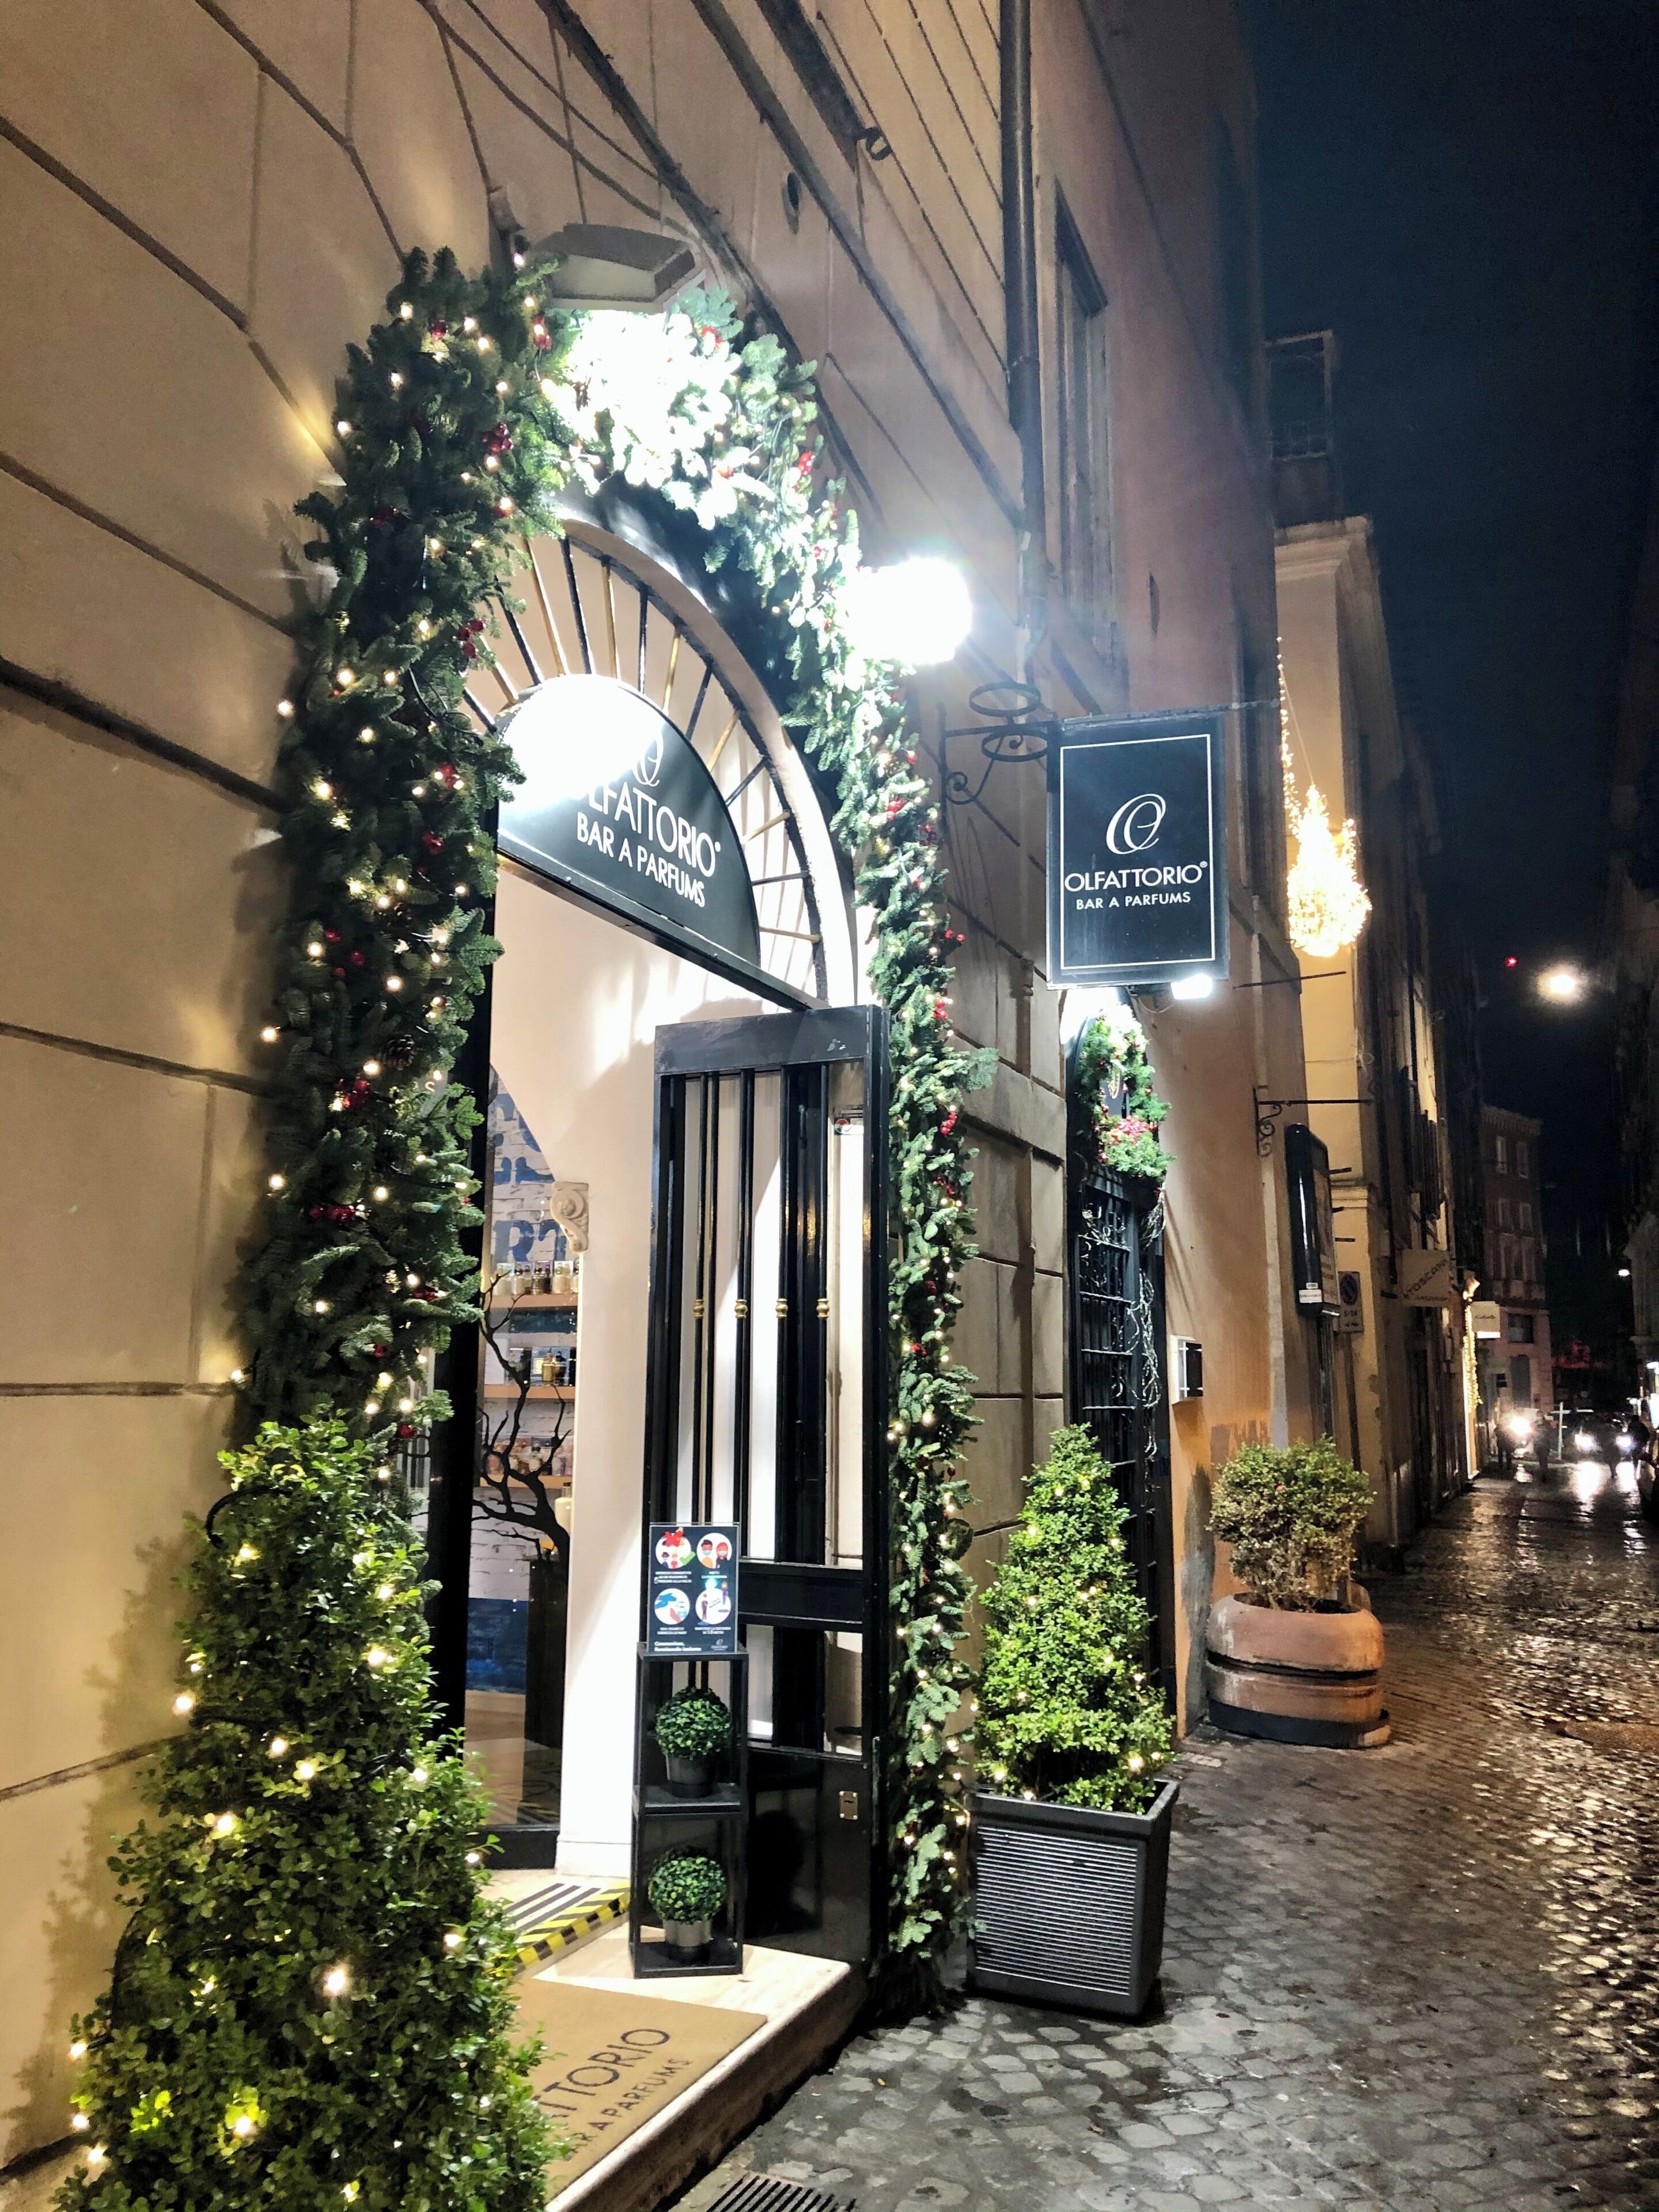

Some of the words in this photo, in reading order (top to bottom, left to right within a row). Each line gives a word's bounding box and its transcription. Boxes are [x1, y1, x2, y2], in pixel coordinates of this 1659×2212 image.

[577, 811, 613, 858] BAR
[618, 838, 633, 868] A
[637, 845, 705, 908] PARFUMS
[588, 782, 716, 877] LFATTORIO
[1076, 898, 1103, 910] BAR
[1108, 896, 1119, 908] A
[1126, 891, 1191, 907] PARFUMS
[532, 2028, 670, 2119] TTORIO
[601, 2058, 694, 2119] PARFUMS
[588, 2121, 615, 2131] A
